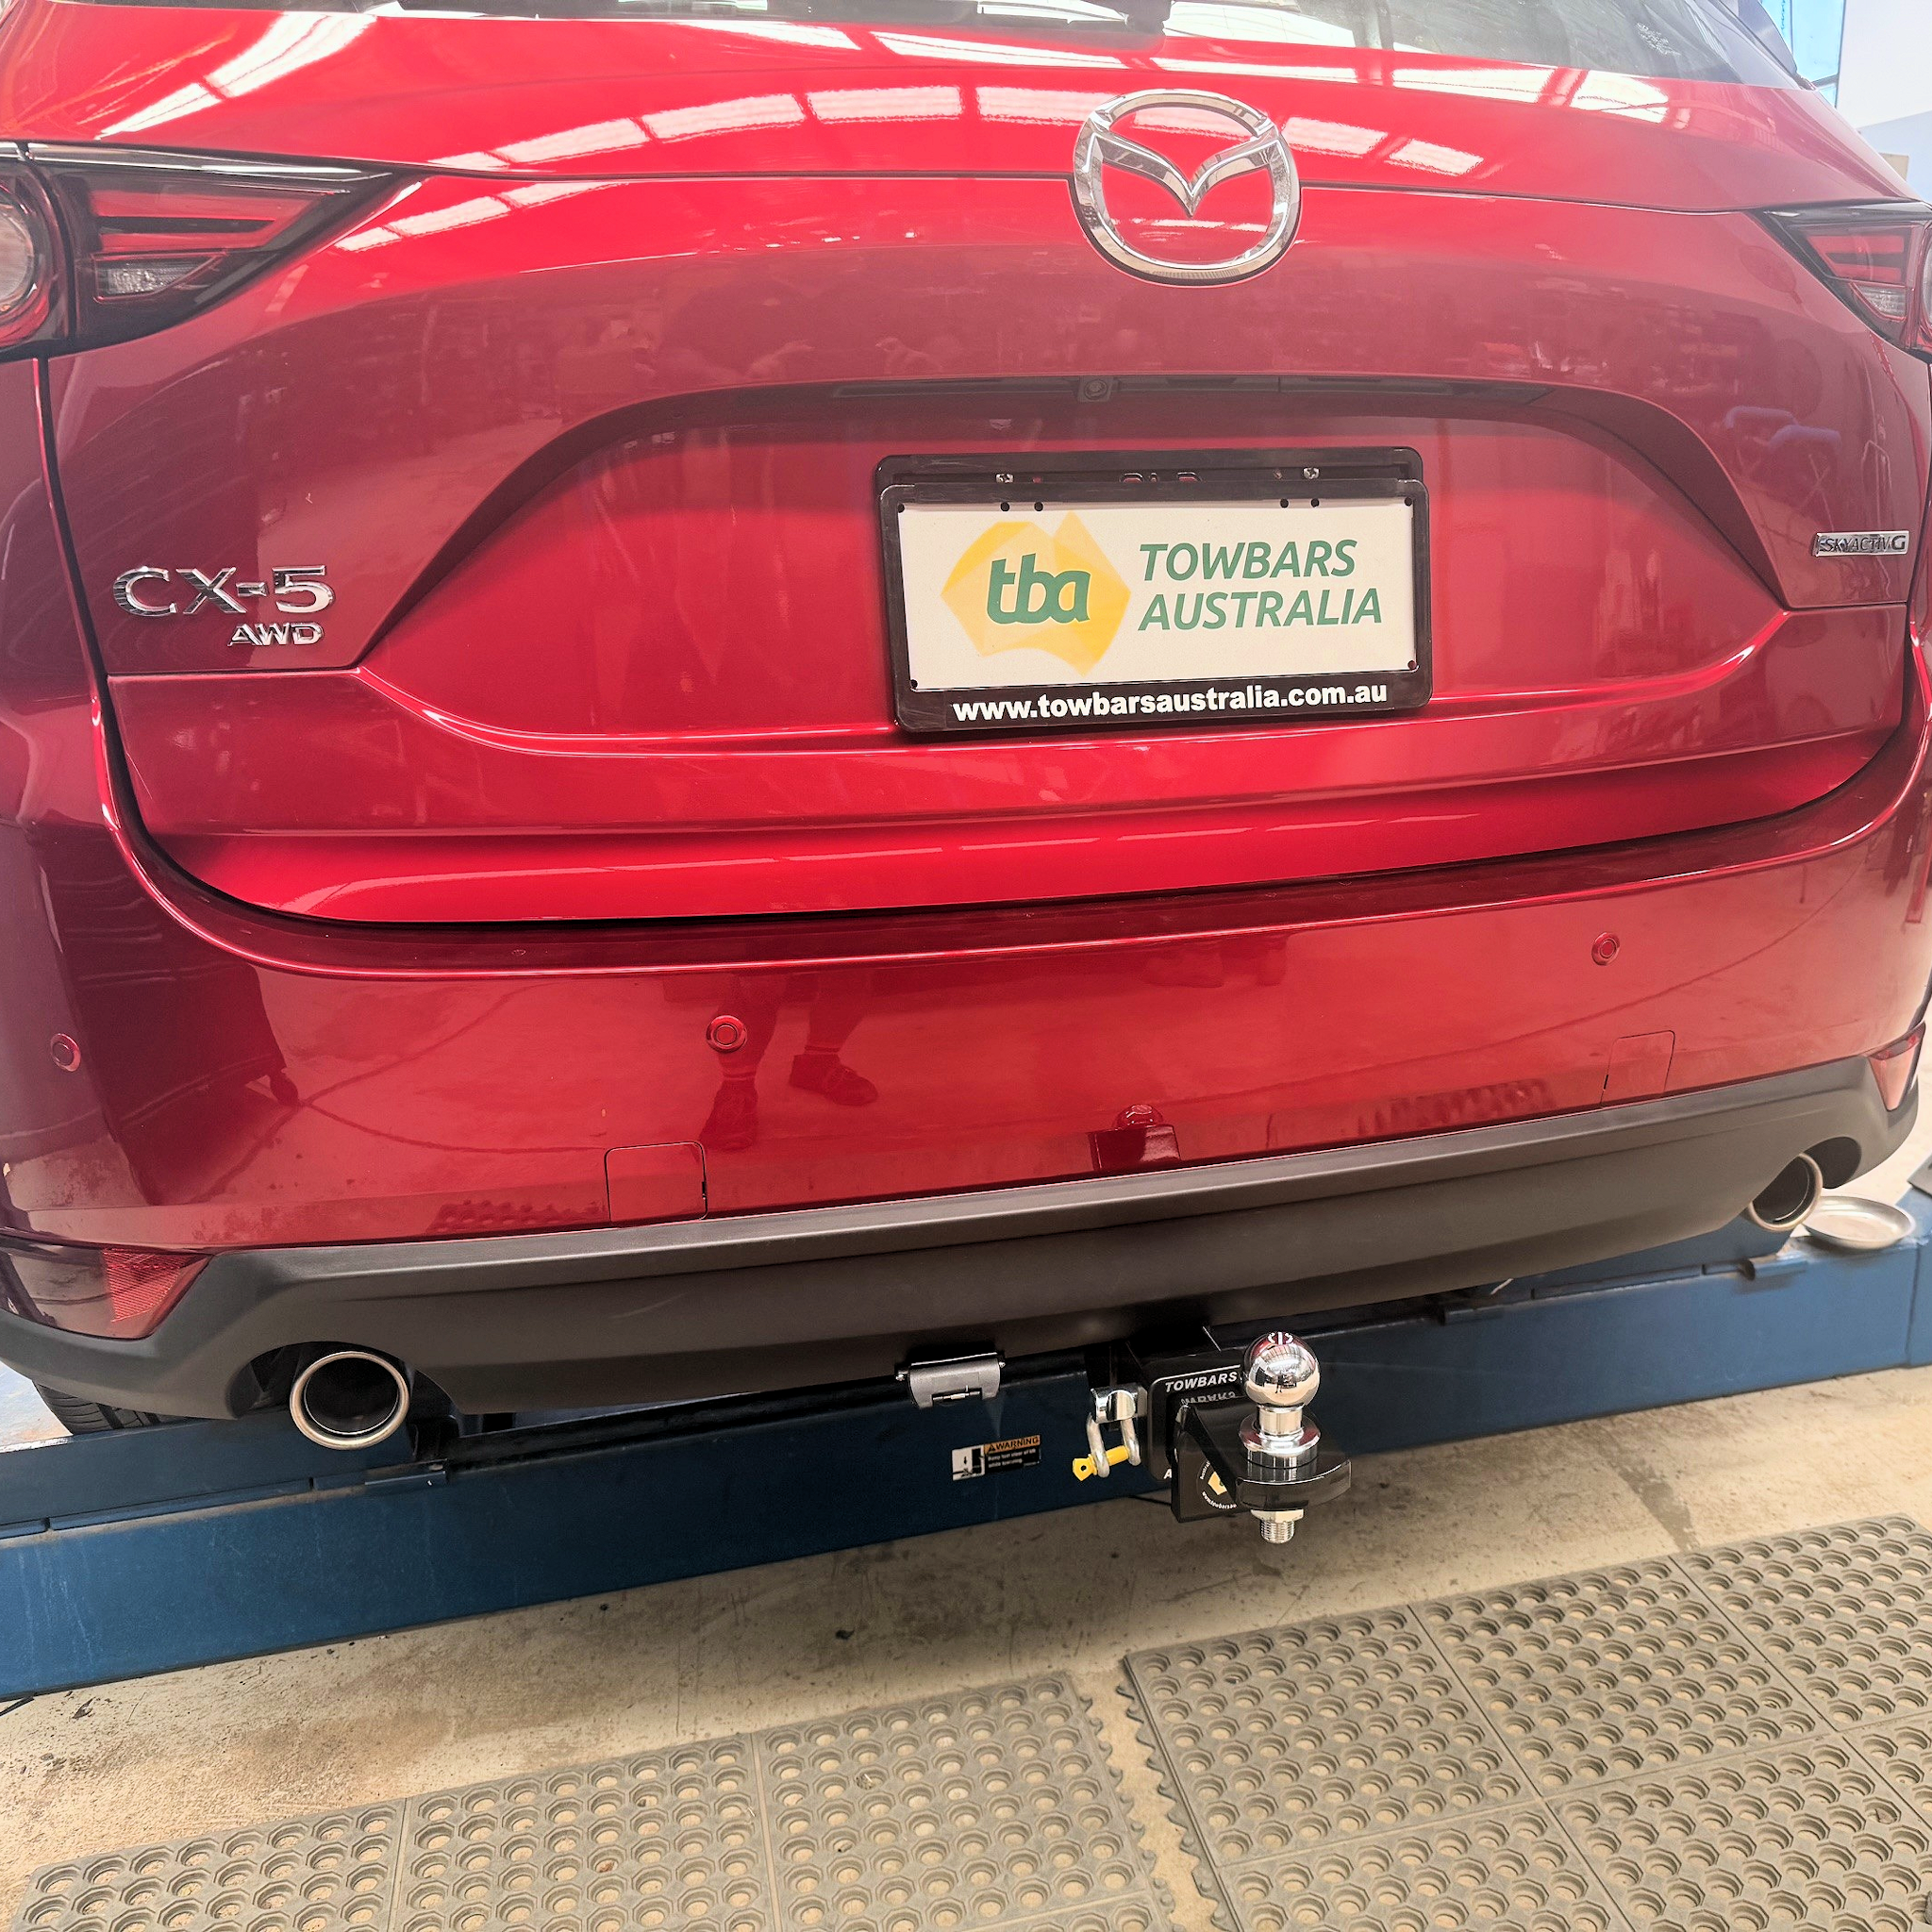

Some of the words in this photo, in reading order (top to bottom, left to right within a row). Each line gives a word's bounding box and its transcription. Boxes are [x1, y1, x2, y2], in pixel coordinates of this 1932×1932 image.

[1139, 539, 1357, 581] TOWBARS
[113, 565, 335, 616] CX-5
[988, 553, 1091, 624] tba
[1138, 588, 1382, 631] AUSTRALIA
[227, 622, 325, 646] AWD
[953, 685, 1387, 721] www.towbarsaustralia.com.au
[1165, 1372, 1237, 1392] TOWBARS
[995, 1438, 1039, 1450] WARNING
